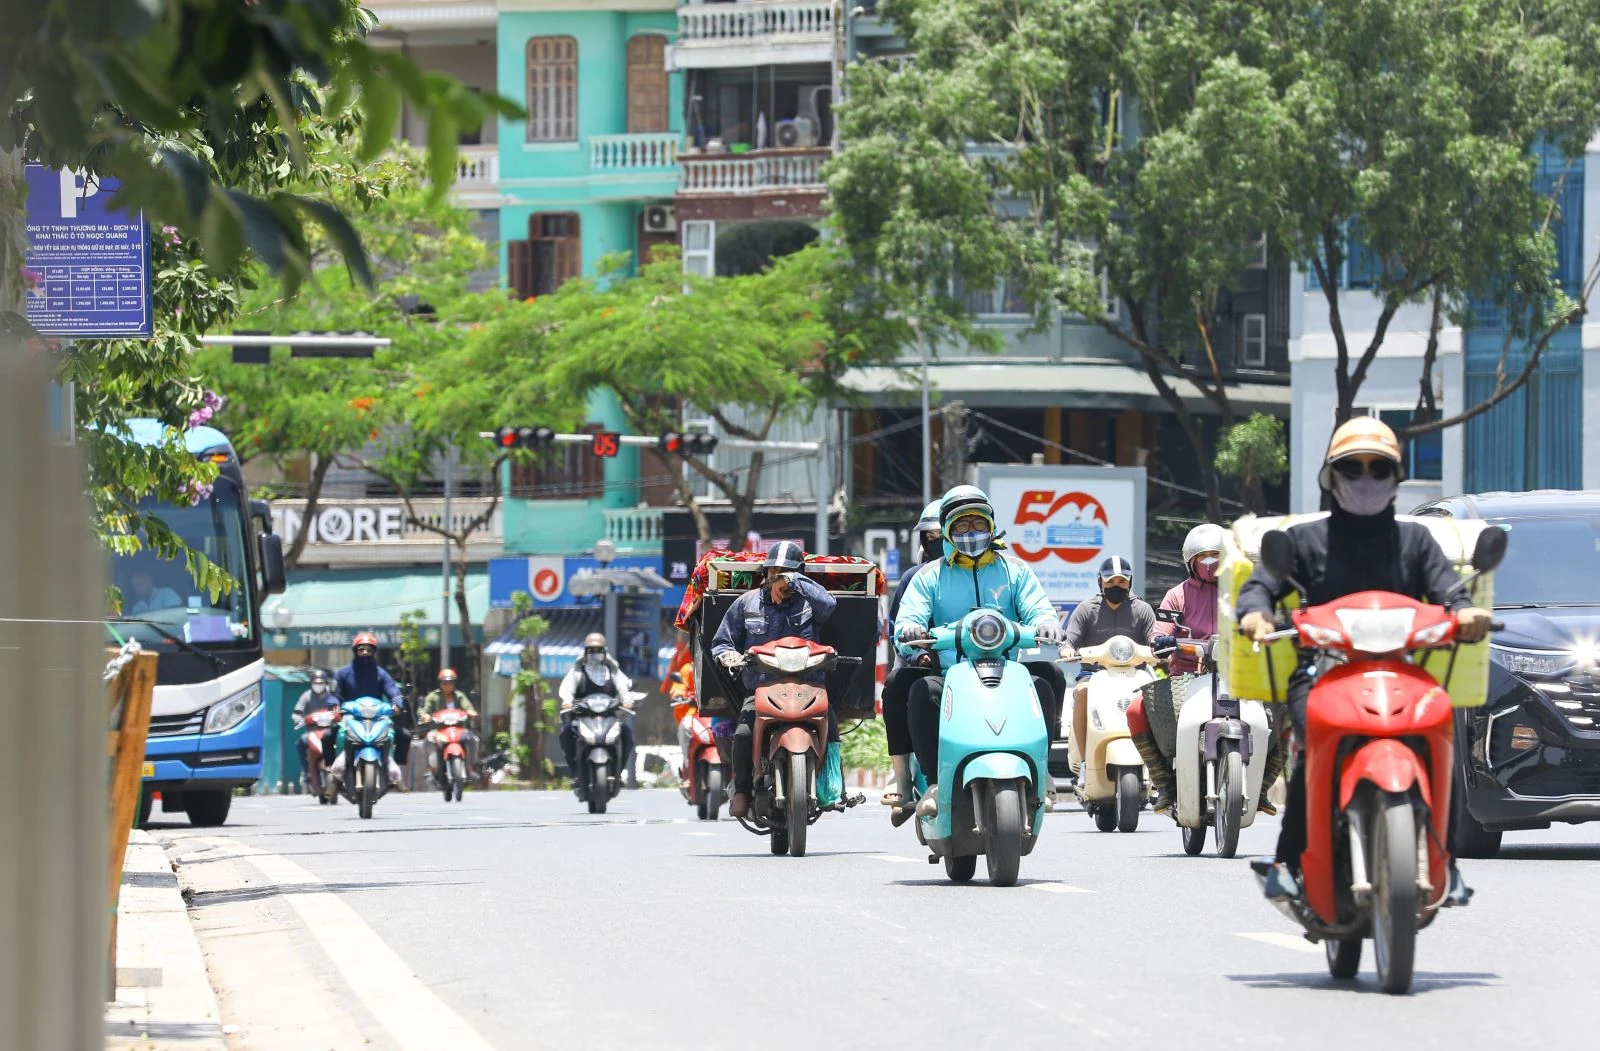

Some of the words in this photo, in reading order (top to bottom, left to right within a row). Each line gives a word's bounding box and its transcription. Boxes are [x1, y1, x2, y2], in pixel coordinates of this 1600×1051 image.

[60, 164, 100, 218] P
[26, 224, 41, 232] ÔNG
[113, 224, 129, 232] DỊCH
[130, 224, 139, 232] VỤ
[52, 231, 69, 240] THÁC
[76, 231, 86, 239] TÔ
[86, 232, 105, 240] NGỌC
[594, 433, 617, 457] 05
